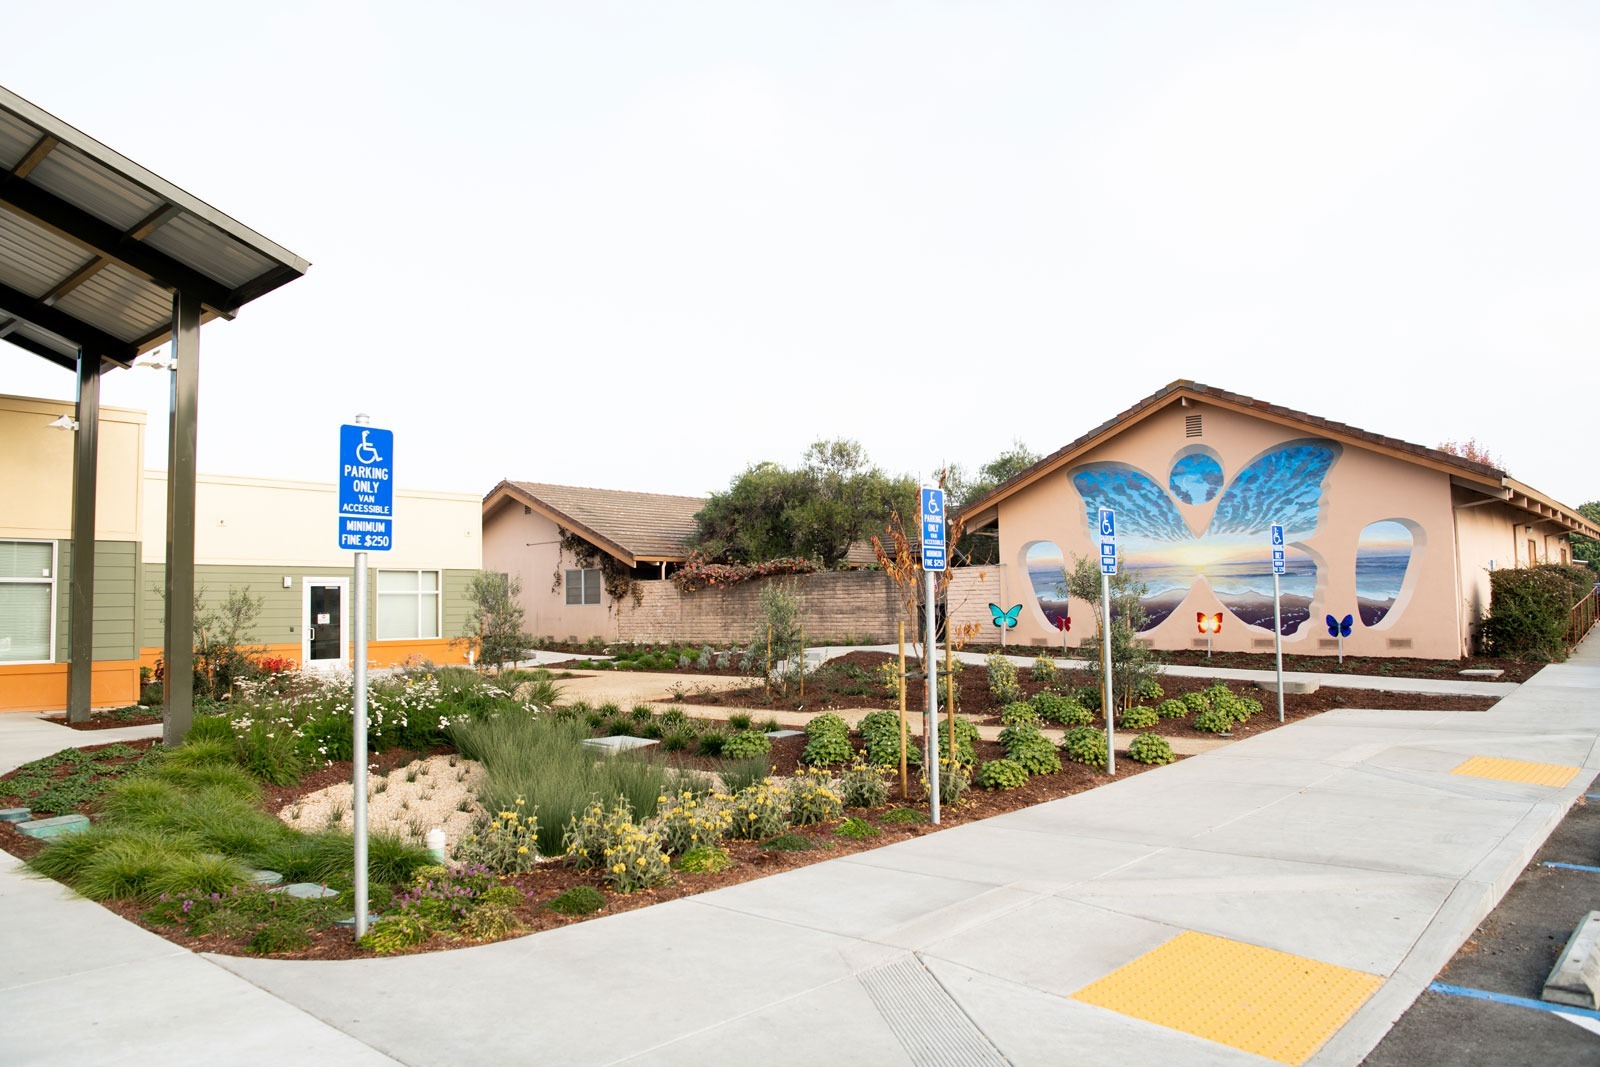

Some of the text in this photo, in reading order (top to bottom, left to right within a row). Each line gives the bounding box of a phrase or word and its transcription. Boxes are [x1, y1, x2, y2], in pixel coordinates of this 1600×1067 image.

[344, 464, 389, 480] PARKING
[353, 480, 380, 494] ONLY
[358, 494, 375, 503] VAN
[342, 504, 390, 514] ACCESSIBLE
[924, 514, 942, 524] PARKING
[346, 520, 385, 532] MINIMUM
[928, 524, 938, 532] ONLY
[342, 534, 389, 547] FINE $250
